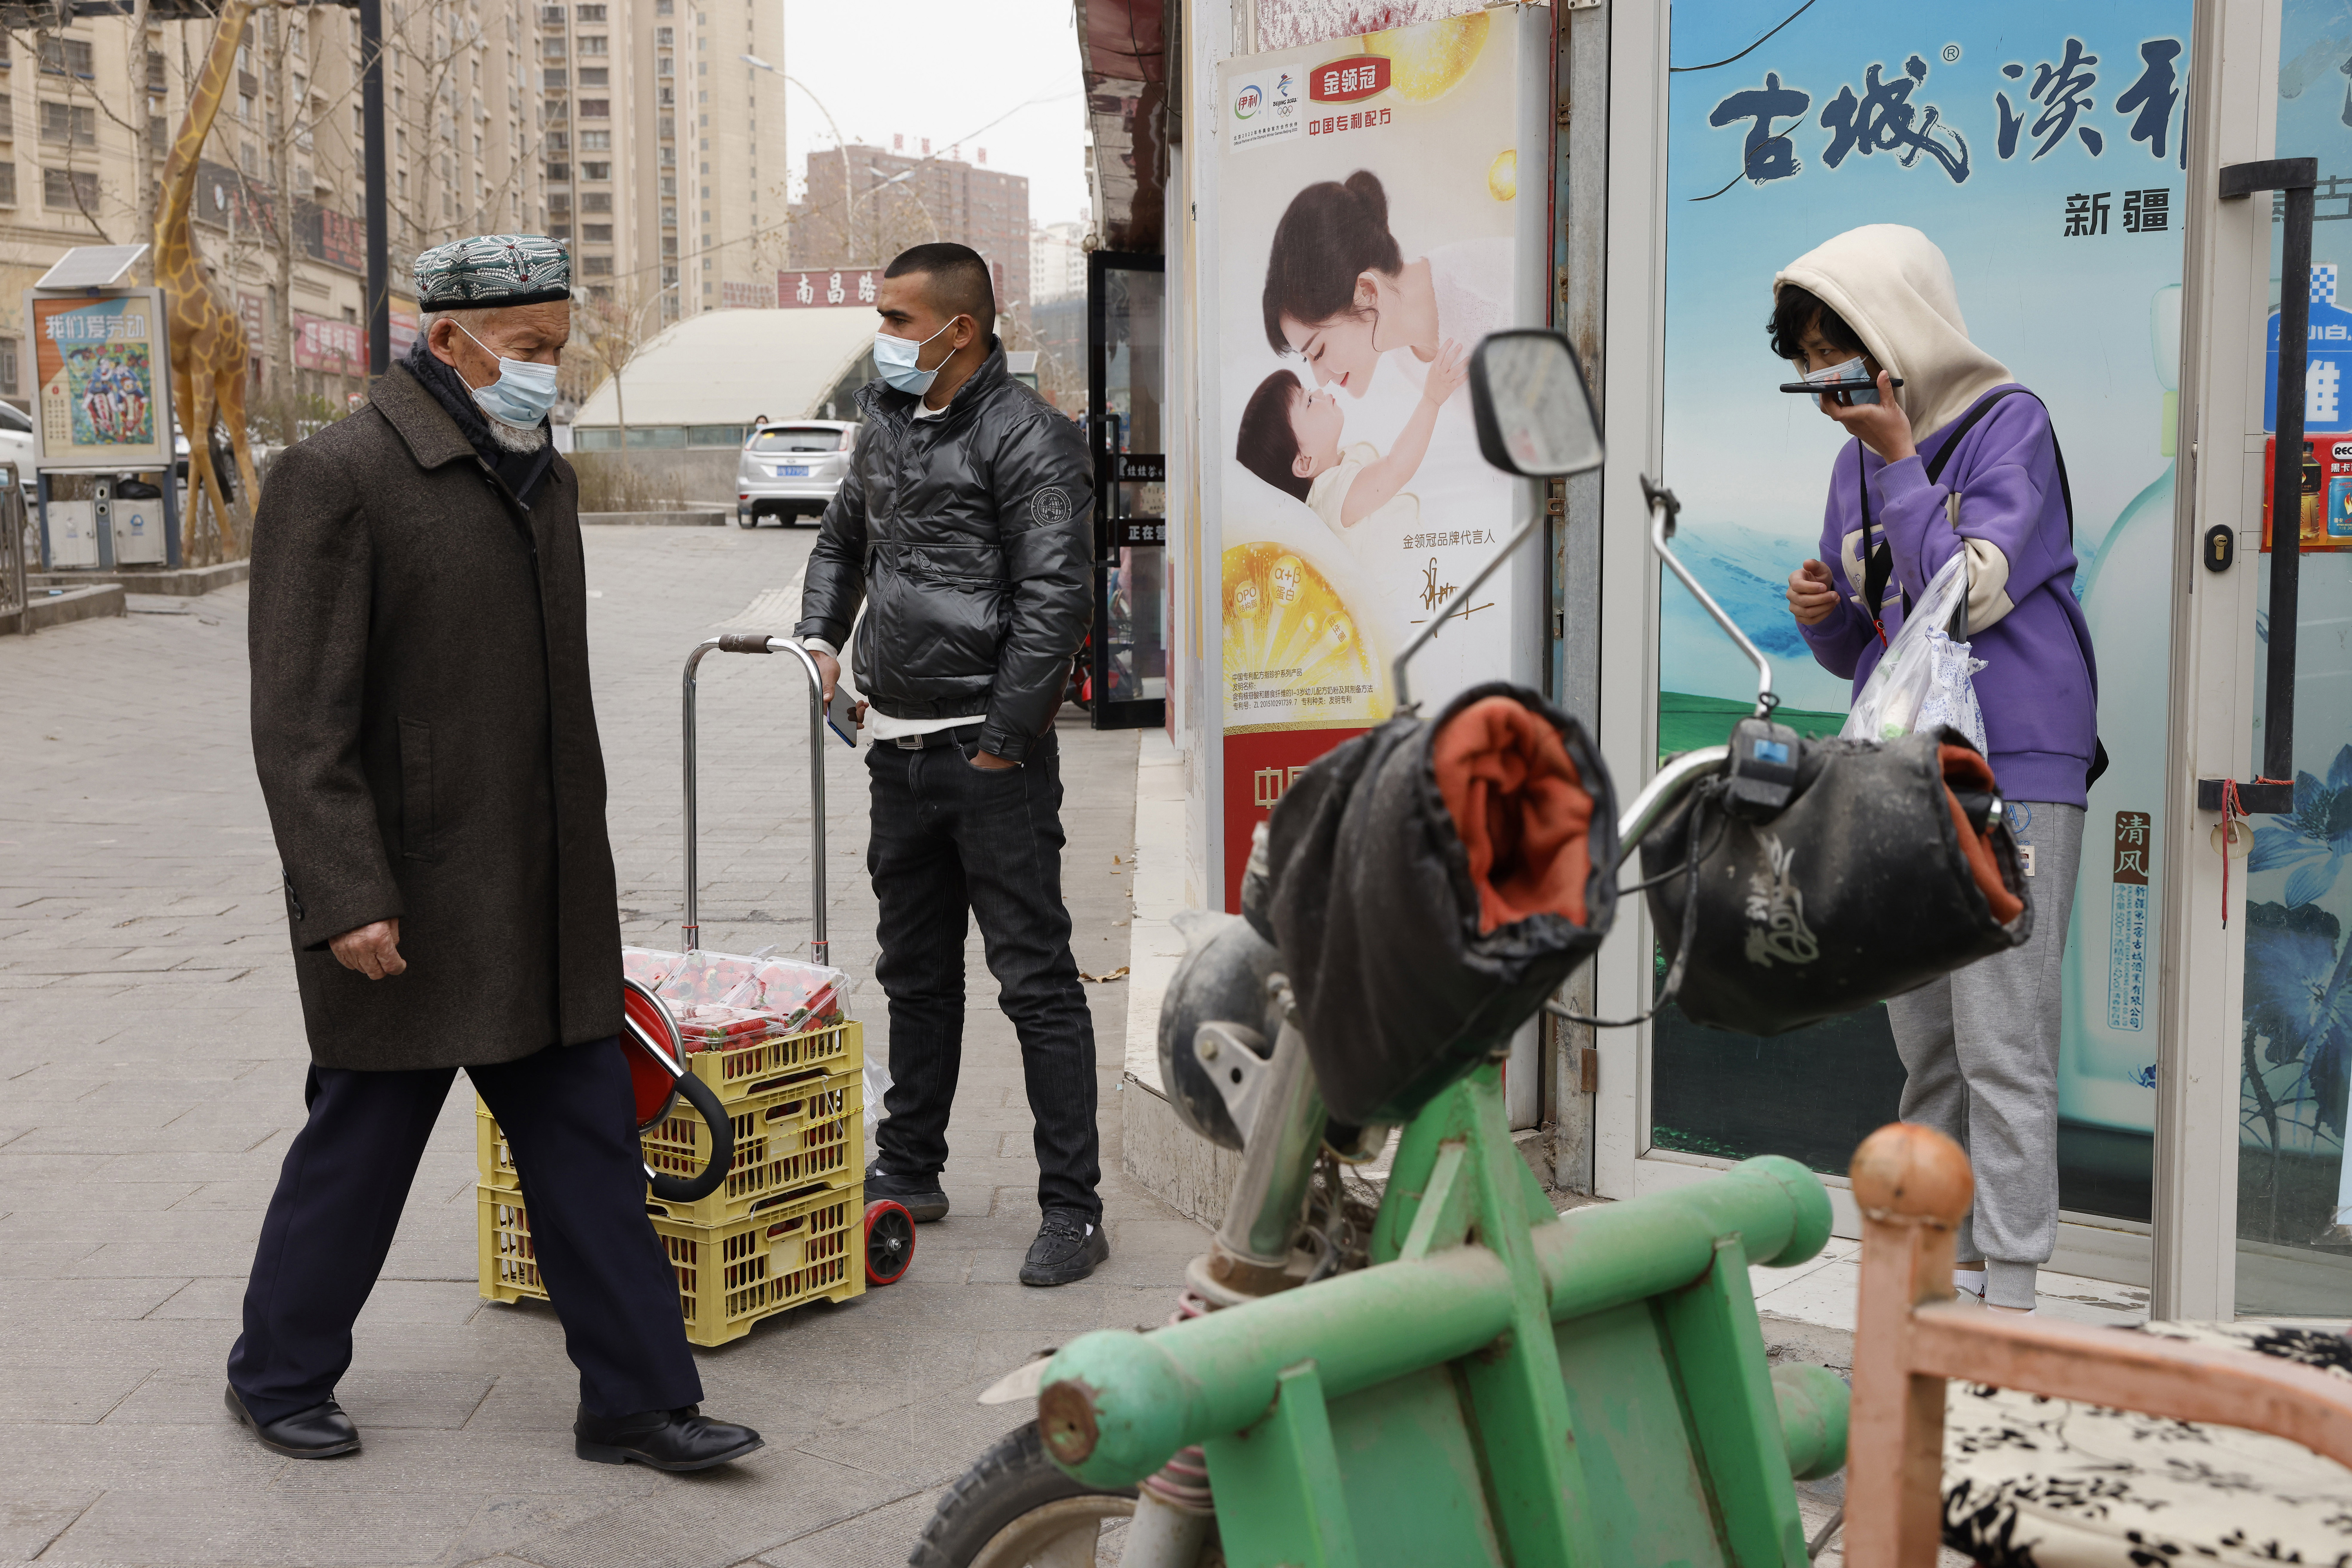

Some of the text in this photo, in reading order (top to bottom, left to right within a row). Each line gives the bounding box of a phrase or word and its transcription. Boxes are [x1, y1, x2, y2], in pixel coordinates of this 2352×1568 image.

[1324, 65, 1376, 95] 金领冠
[1238, 94, 1258, 111] 伊利
[1309, 108, 1391, 136] 中国专利配方
[1710, 55, 1970, 186] 古城
[1234, 122, 1298, 141] 北京2022年冬奥会官方合作伙伴
[2064, 188, 2170, 237] 新疆
[796, 271, 877, 305] 南昌路
[45, 315, 145, 339] 我们爱劳动
[2276, 324, 2347, 341] 小白
[2331, 463, 2352, 472] 黑卡
[1034, 490, 1051, 505] AUTHENTIC
[1403, 529, 1495, 549] 金领冠品牌代言人
[1275, 567, 1301, 587] α+β
[1237, 587, 1257, 603] OPO
[1276, 586, 1294, 601] 蛋白
[1239, 599, 1257, 613] 结构脂
[1327, 616, 1347, 642] 益生菌
[1232, 668, 1302, 681] 中国专利配方指珍护系列产品
[1232, 682, 1256, 691] 发明名称：
[1254, 766, 1309, 810] 中
[2114, 814, 2150, 877] 清风
